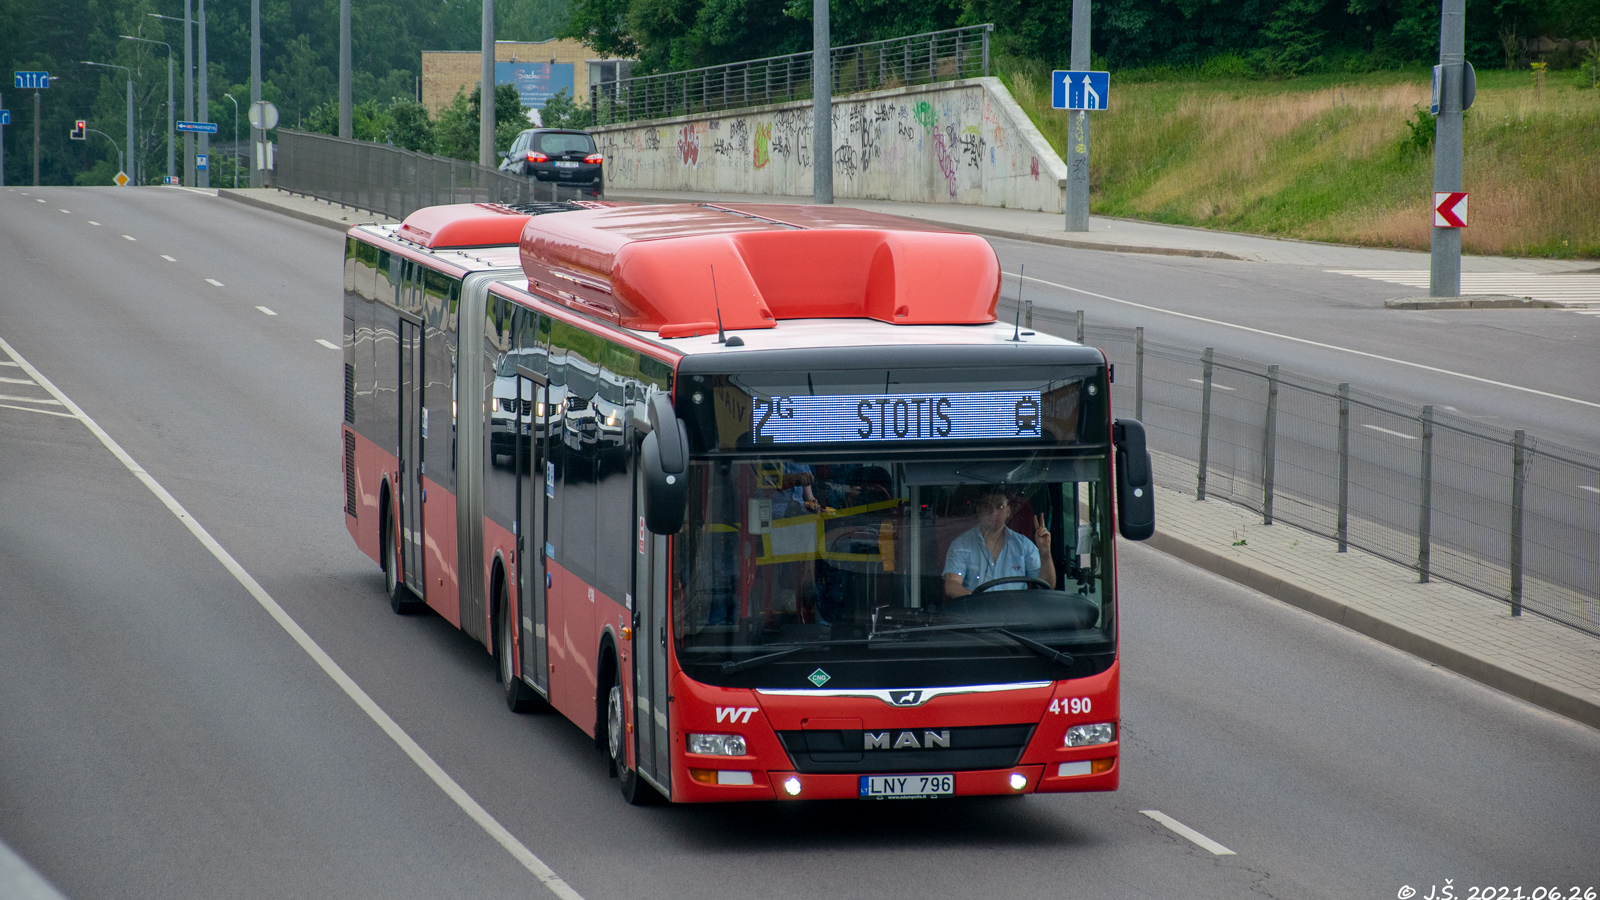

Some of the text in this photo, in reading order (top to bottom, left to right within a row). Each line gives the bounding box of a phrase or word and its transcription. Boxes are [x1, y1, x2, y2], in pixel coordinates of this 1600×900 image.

[857, 398, 952, 438] STOTIS
[1048, 697, 1092, 715] 4190
[714, 707, 760, 724] VVT
[863, 731, 951, 750] MAN
[870, 776, 951, 794] LNY 796
